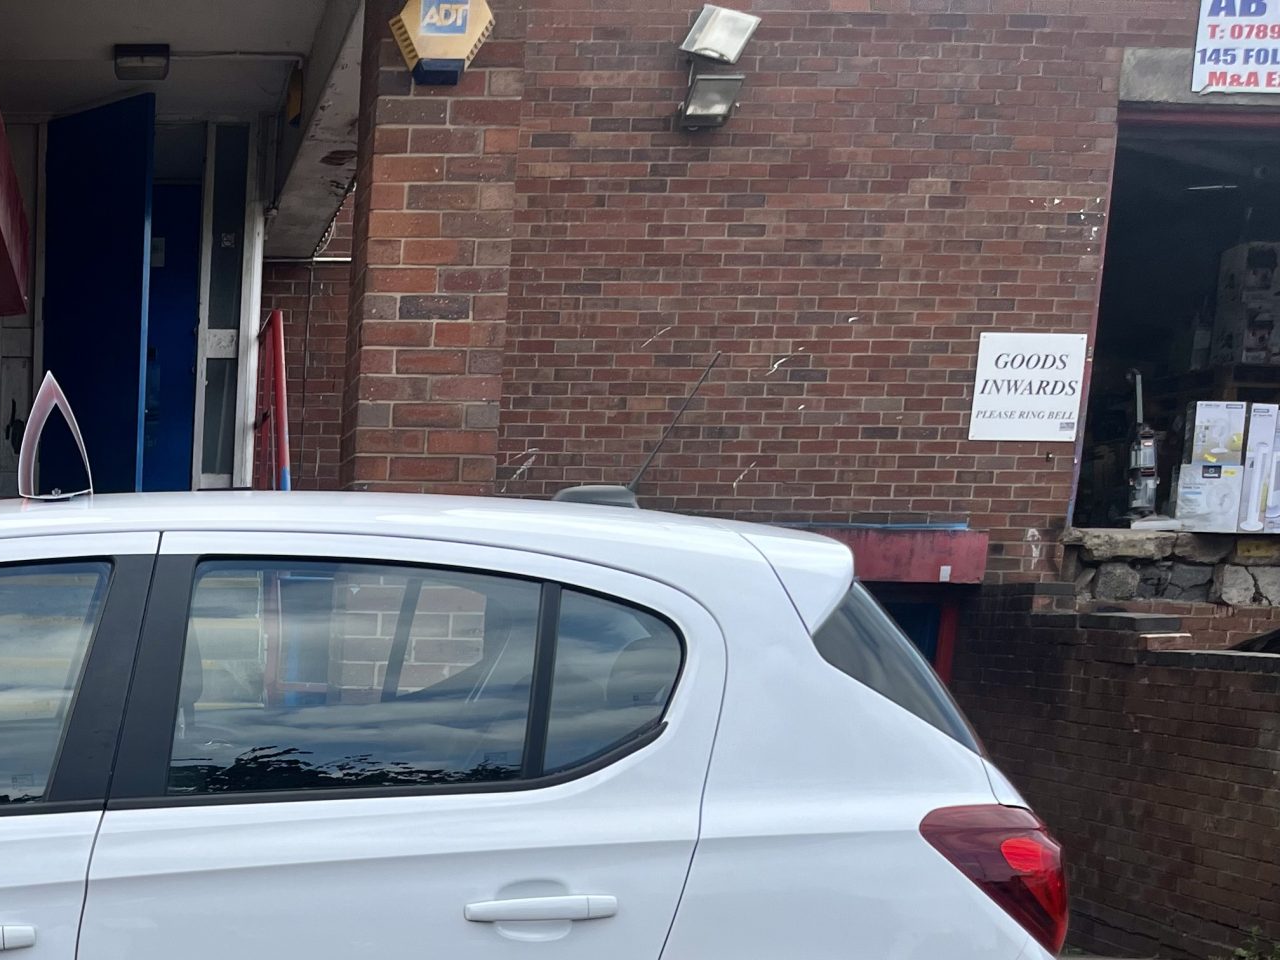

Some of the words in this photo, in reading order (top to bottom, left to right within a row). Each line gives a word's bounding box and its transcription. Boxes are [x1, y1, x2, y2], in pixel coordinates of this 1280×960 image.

[422, 4, 467, 27] ADT
[1197, 48, 1237, 65] 145
[1207, 71, 1260, 88] M&A
[994, 352, 1070, 370] GOODS
[978, 378, 1078, 396] INWARDS
[975, 409, 1017, 420] PLEASE
[1018, 409, 1045, 420] RING
[1047, 410, 1075, 420] BELL
